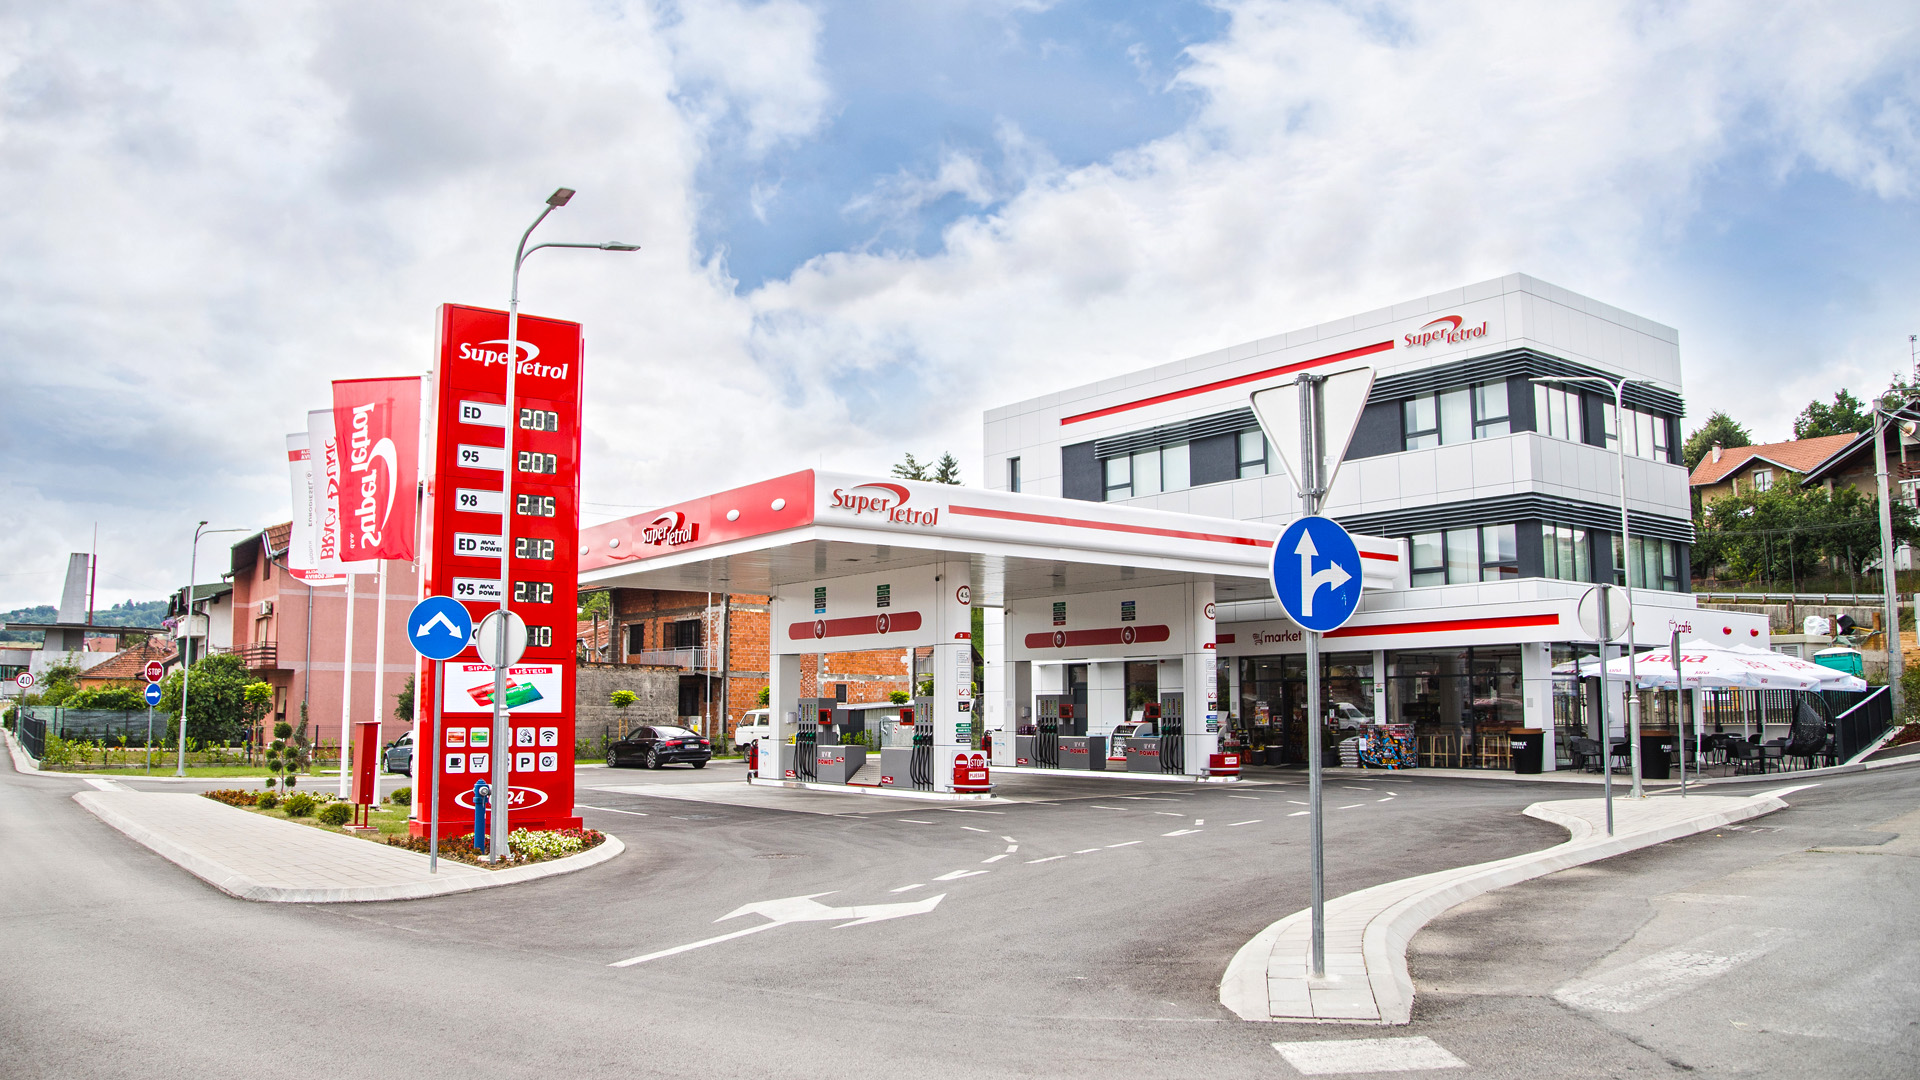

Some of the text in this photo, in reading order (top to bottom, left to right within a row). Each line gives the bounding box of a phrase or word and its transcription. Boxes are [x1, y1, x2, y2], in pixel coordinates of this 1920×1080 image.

[463, 406, 558, 432] ED 2.07
[462, 450, 557, 474] 95 2.07
[460, 494, 556, 517] 98 2.15
[458, 538, 555, 560] ED 2.12
[457, 581, 554, 604] 95 2.12
[816, 617, 886, 635] 4 2
[1678, 621, 1692, 634] café
[1264, 630, 1302, 643] market
[147, 667, 162, 676] STOP
[20, 677, 31, 685] 40
[970, 759, 984, 767] STOP
